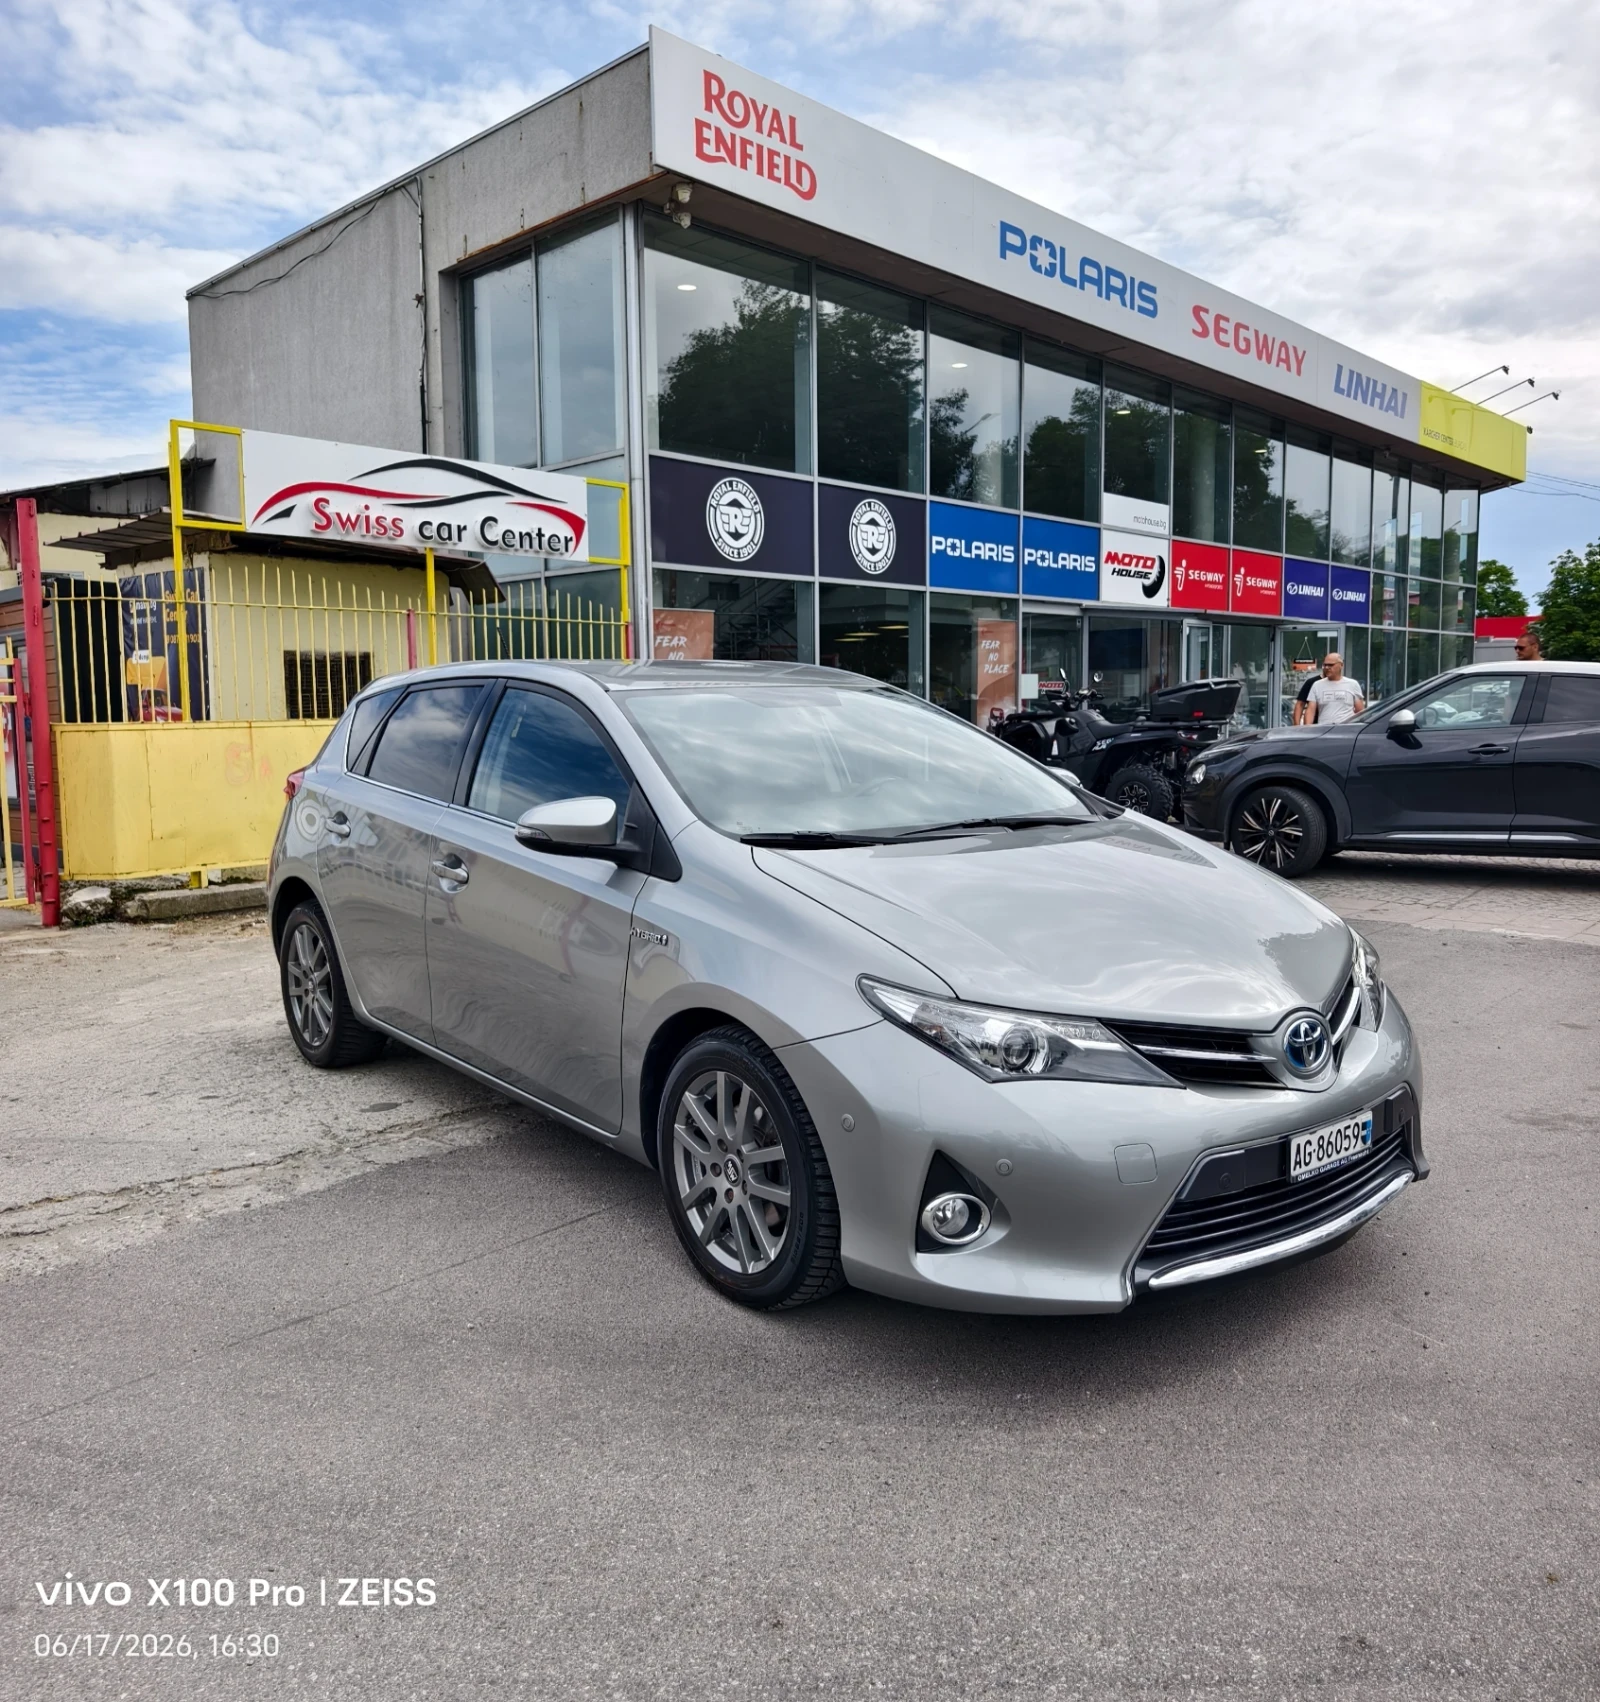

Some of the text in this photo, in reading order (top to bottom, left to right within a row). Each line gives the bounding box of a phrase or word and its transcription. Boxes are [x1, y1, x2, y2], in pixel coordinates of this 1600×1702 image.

[703, 69, 803, 151] ROYAL
[694, 117, 817, 200] ENFIELD
[1000, 220, 1158, 319] POLARIS
[1191, 304, 1306, 376] SEGWAY
[1334, 363, 1408, 419] LINHAI
[710, 481, 760, 513] ROYAL ENFIELD
[852, 502, 870, 526] ROYAL
[312, 497, 574, 553] Swiss car Center
[717, 538, 756, 558] SINCE 1901
[931, 535, 1015, 563] POLARIS
[1024, 548, 1096, 573] POLARIS
[1104, 551, 1156, 570] MOTO
[1111, 567, 1152, 580] HOUSE
[1188, 570, 1224, 583] SEGWAY
[1246, 576, 1277, 589] SEGWAY
[1298, 584, 1324, 597] LINHAI
[1342, 590, 1366, 603] LINHAI
[655, 636, 687, 648] FEAR
[981, 640, 1000, 650] FEAR
[988, 652, 998, 662] NO
[984, 664, 1010, 674] PLACE
